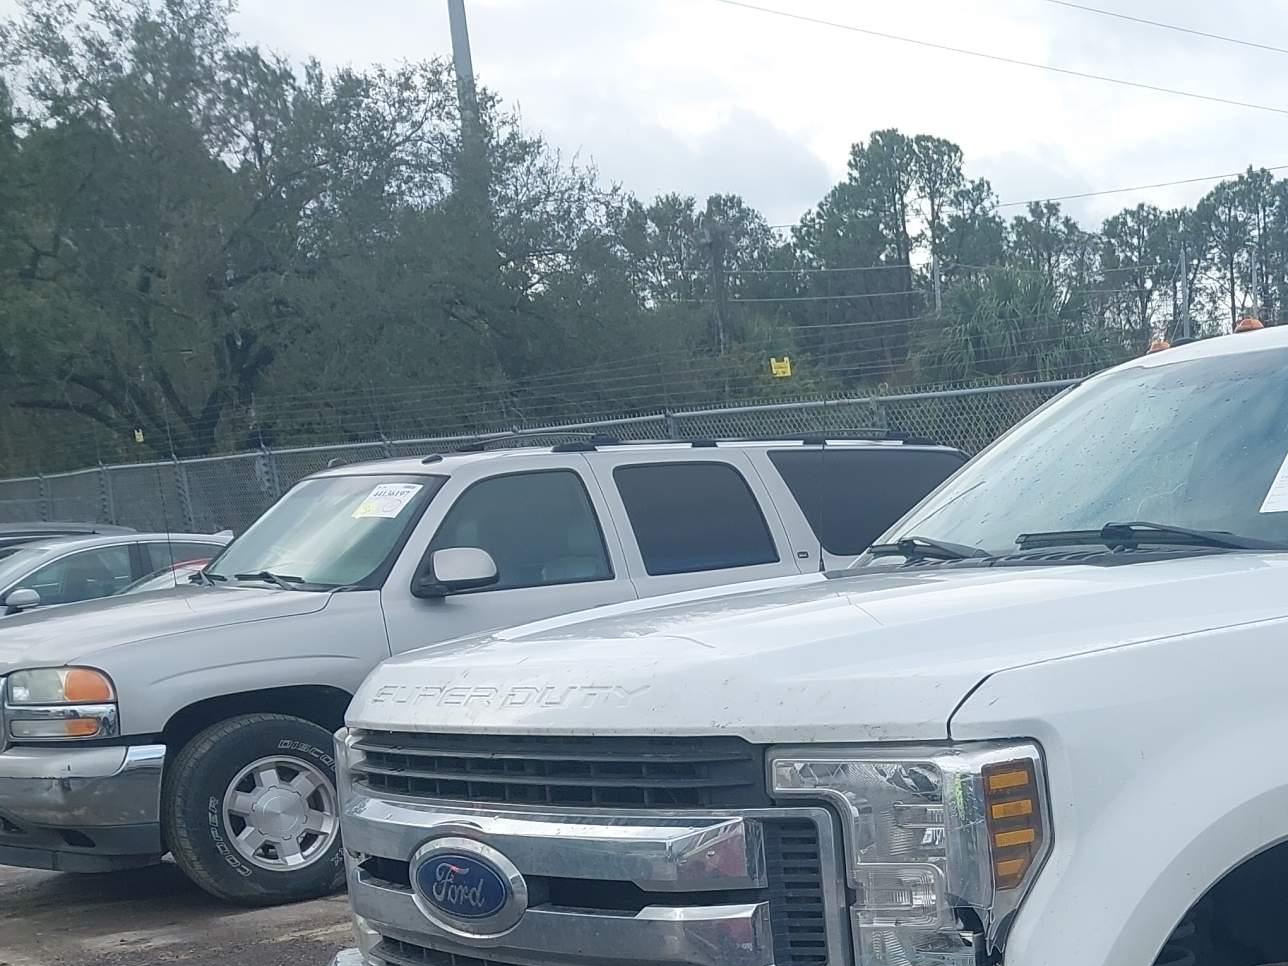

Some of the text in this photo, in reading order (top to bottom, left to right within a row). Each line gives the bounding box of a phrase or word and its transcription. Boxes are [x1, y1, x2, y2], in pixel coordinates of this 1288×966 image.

[371, 684, 650, 709] SUPER DUTY
[208, 796, 253, 877] COOPER
[432, 862, 486, 907] Ford
